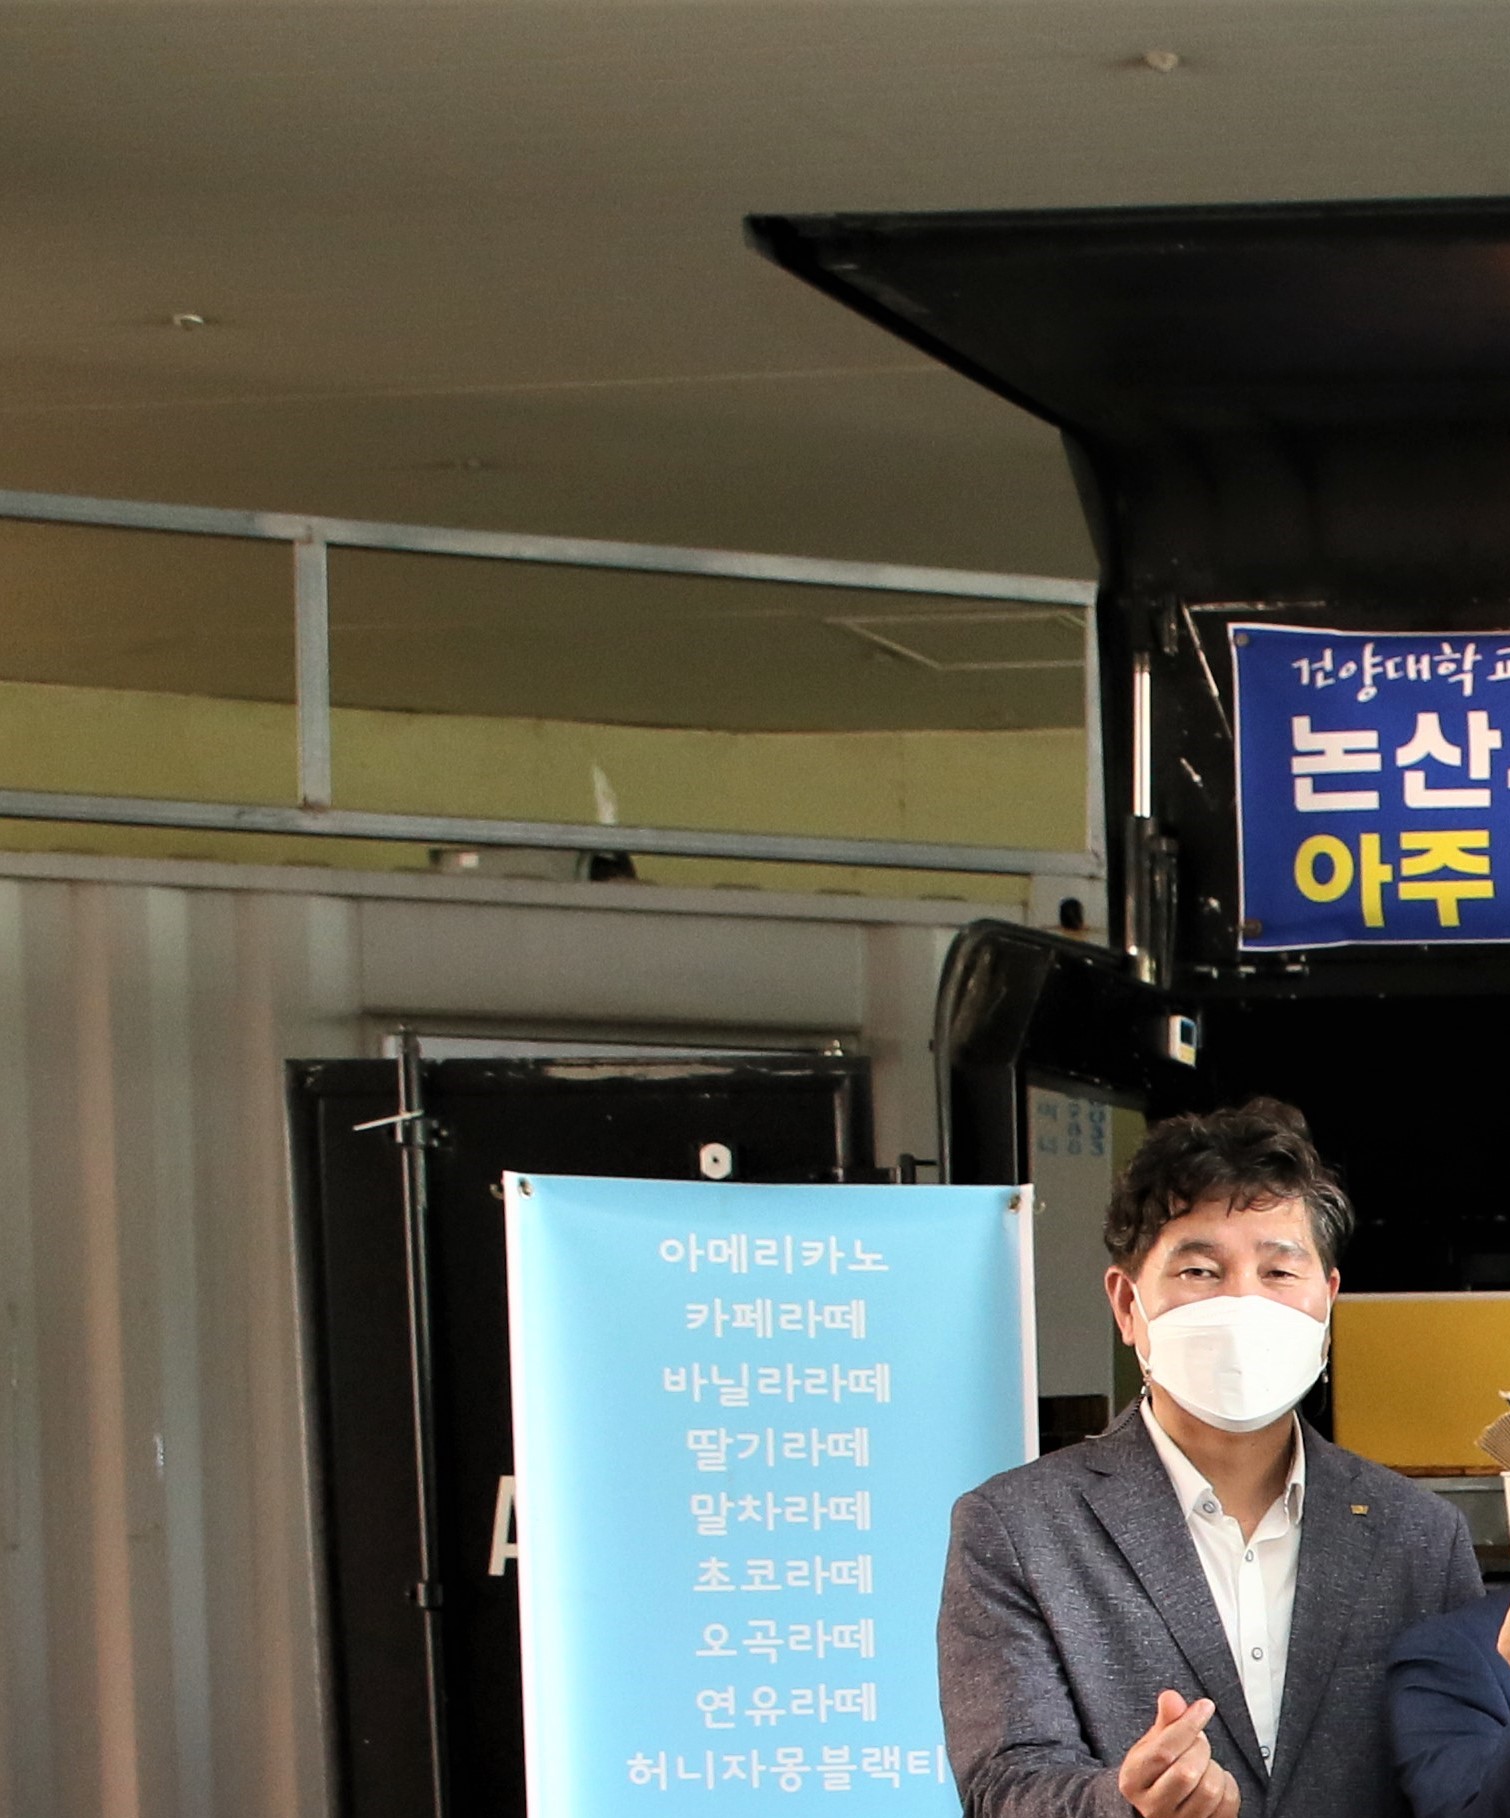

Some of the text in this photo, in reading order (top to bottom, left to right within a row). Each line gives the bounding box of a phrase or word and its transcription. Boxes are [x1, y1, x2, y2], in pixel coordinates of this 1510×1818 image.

[1295, 830, 1494, 926] 아주
[660, 1233, 889, 1274] 아메리카노
[686, 1298, 865, 1338] 카페라떼
[664, 1363, 890, 1406] 바닐라라떼
[687, 1428, 869, 1471] 딸기라떼
[691, 1491, 870, 1535] 말차라떼
[694, 1555, 872, 1594] 초코라떼
[696, 1619, 875, 1664] 오곡라떼
[697, 1683, 876, 1728] 연유라떼
[628, 1746, 946, 1792] 허니자몽블랙티
